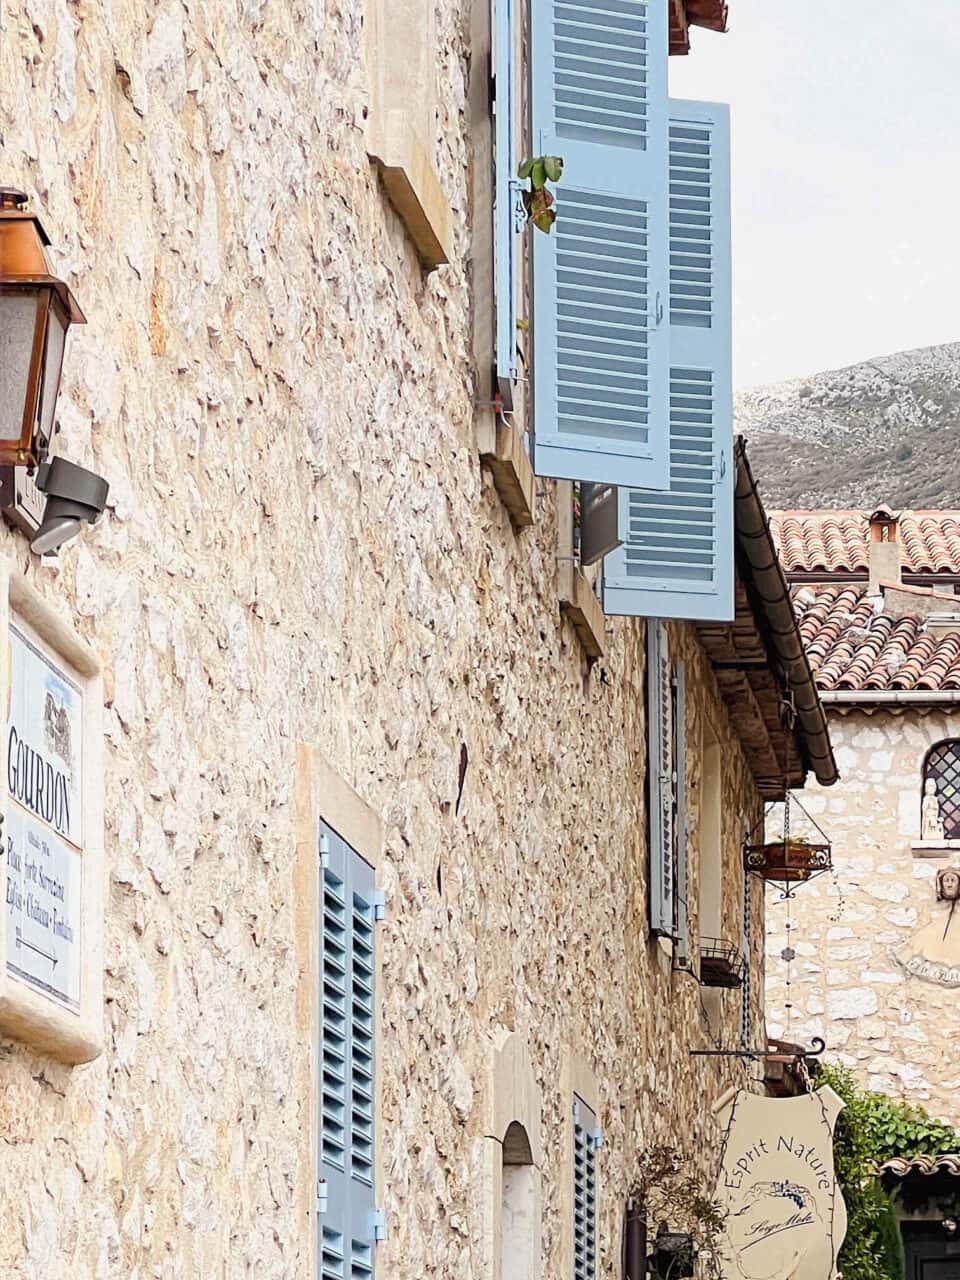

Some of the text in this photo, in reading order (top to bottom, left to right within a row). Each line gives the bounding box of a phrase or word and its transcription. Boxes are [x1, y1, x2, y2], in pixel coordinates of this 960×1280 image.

[8, 725, 71, 836] GOURDON
[724, 1135, 831, 1190] Esprit Nature
